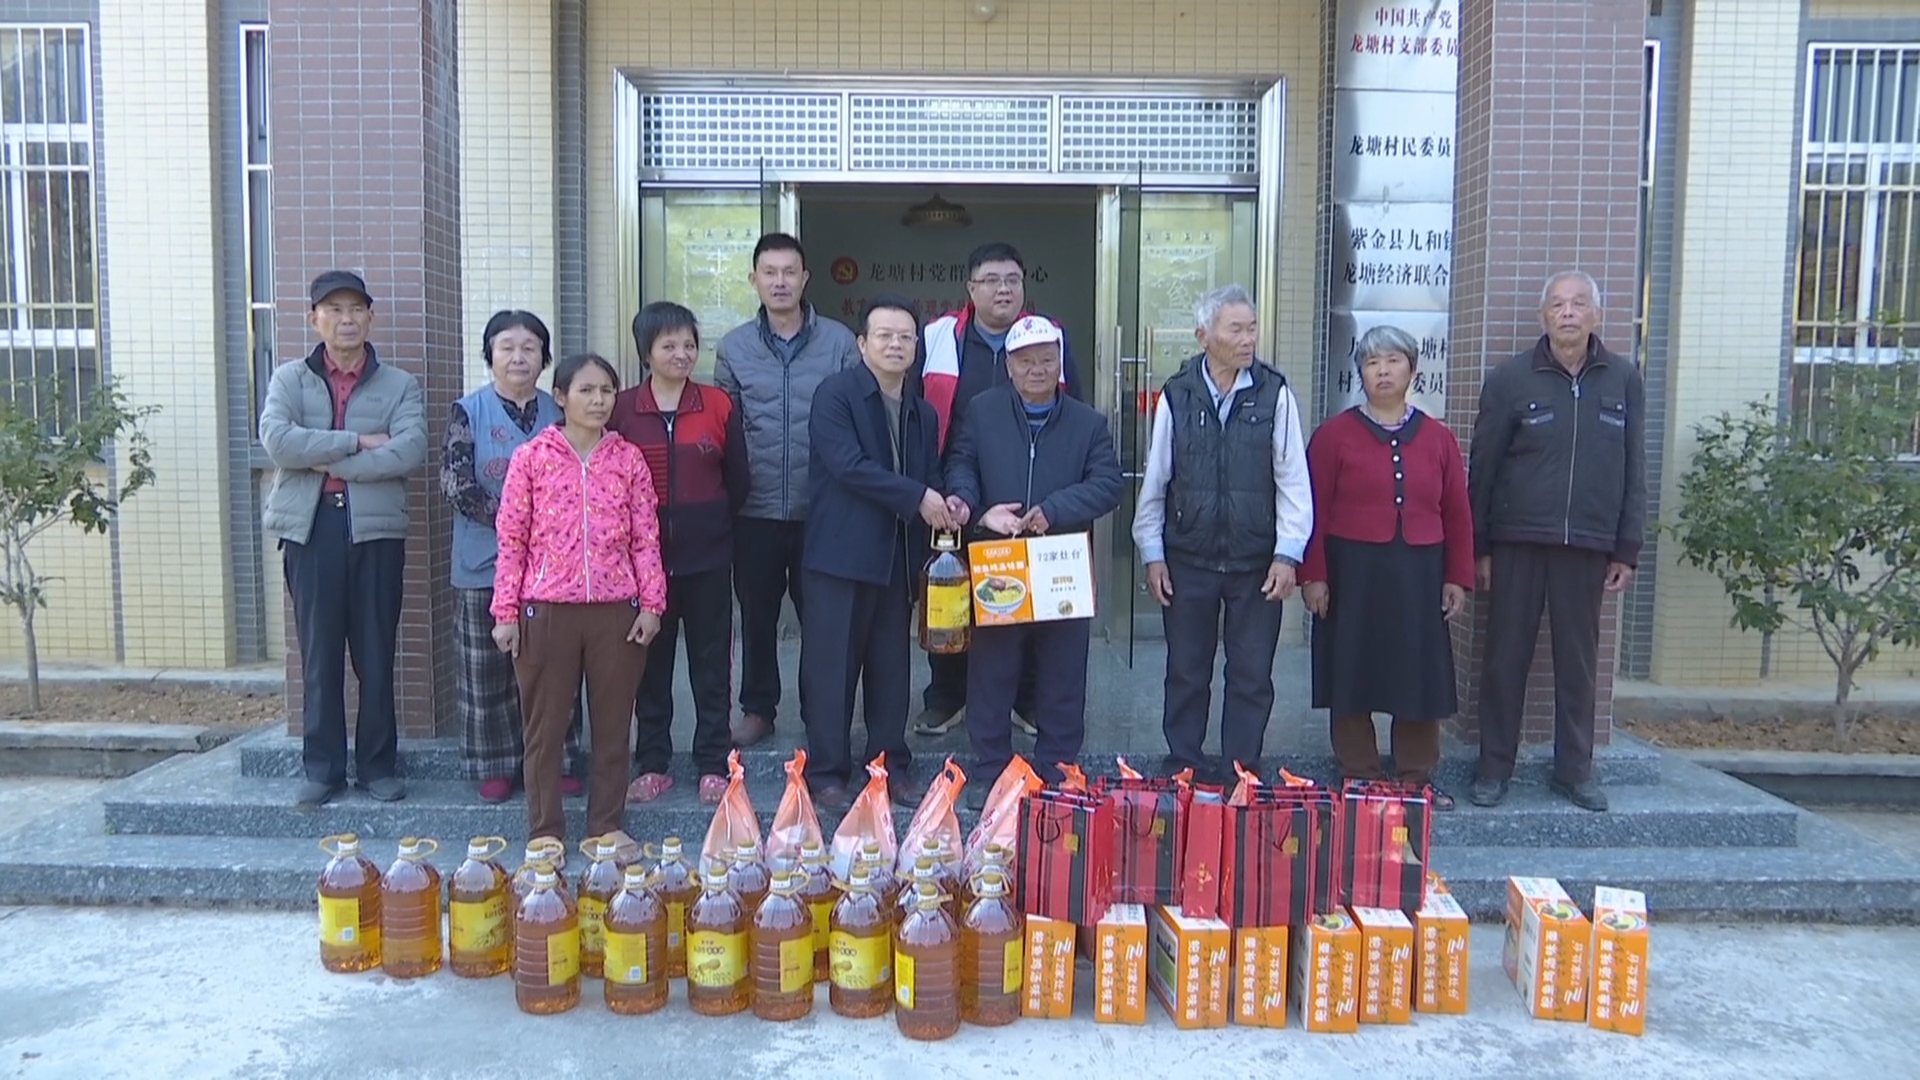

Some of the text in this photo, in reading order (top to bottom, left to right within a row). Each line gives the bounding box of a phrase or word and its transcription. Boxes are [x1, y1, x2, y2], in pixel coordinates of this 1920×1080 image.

[1375, 7, 1452, 29] 中国共产党
[1351, 34, 1459, 57] 龙塘村支部委员
[1350, 135, 1451, 157] 龙塘村民委员
[869, 262, 1049, 284] 龙塘村党群心
[1343, 262, 1449, 286] 龙塘经济联合
